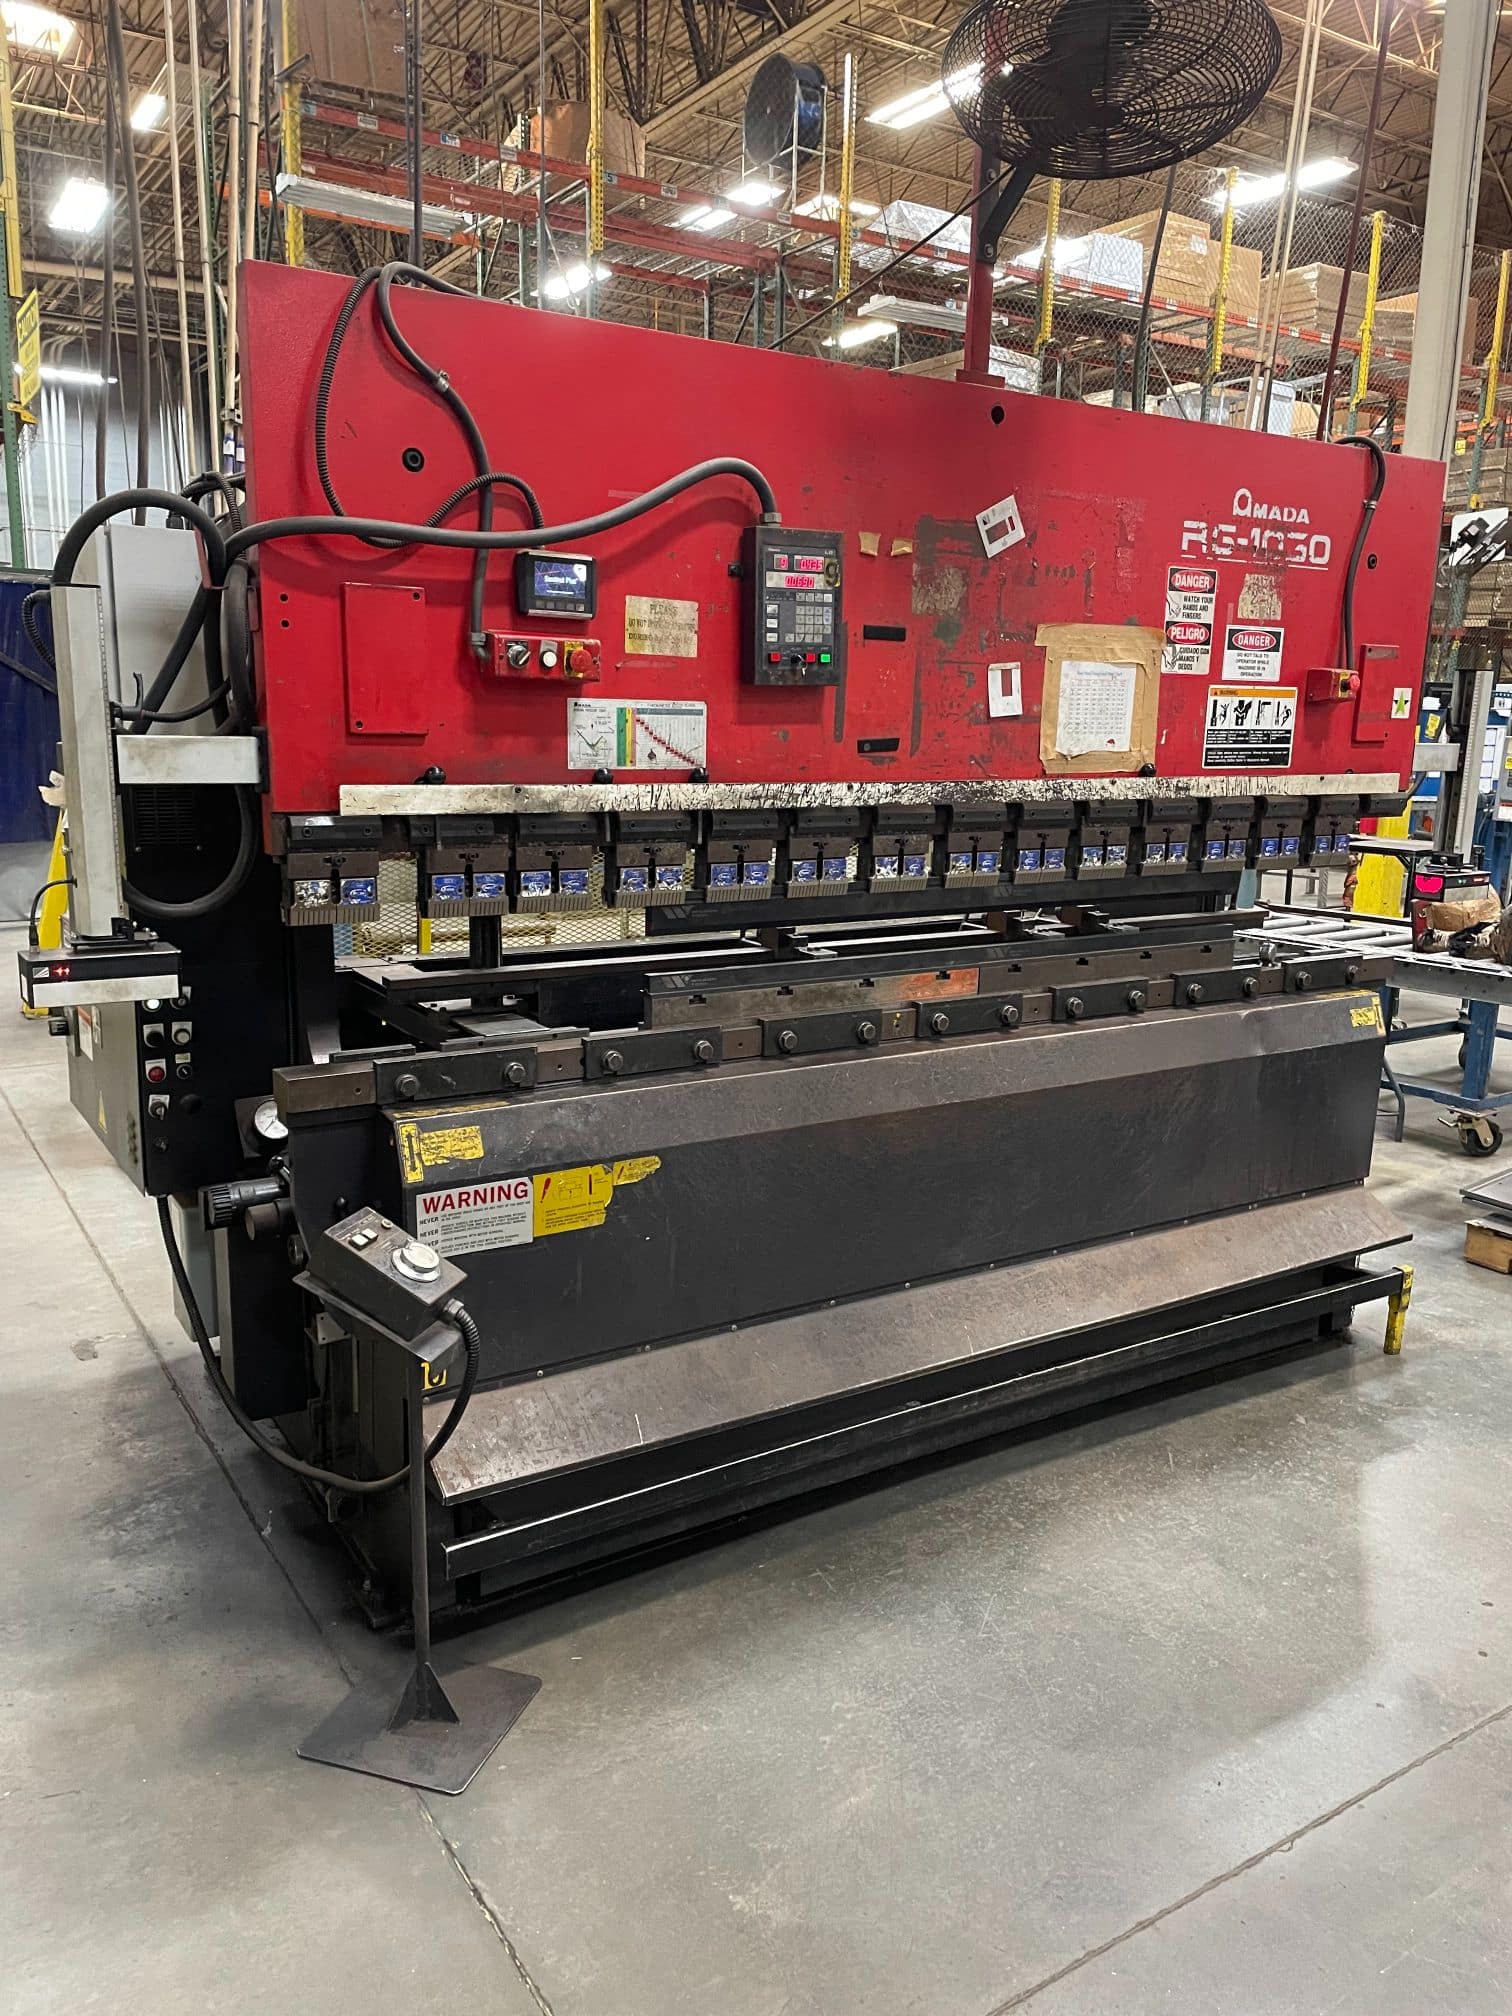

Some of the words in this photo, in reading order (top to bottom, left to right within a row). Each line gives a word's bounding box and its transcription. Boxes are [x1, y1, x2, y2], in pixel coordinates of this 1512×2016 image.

[1232, 488, 1310, 524] AMADA
[1175, 574, 1210, 588] DANGER
[1182, 612, 1201, 620] FINGERS
[1171, 627, 1205, 640] PELIGRO
[1238, 635, 1271, 646] DANGER
[423, 1182, 528, 1214] WARNING
[420, 1216, 439, 1225] NEVER
[420, 1228, 439, 1237] NEVER
